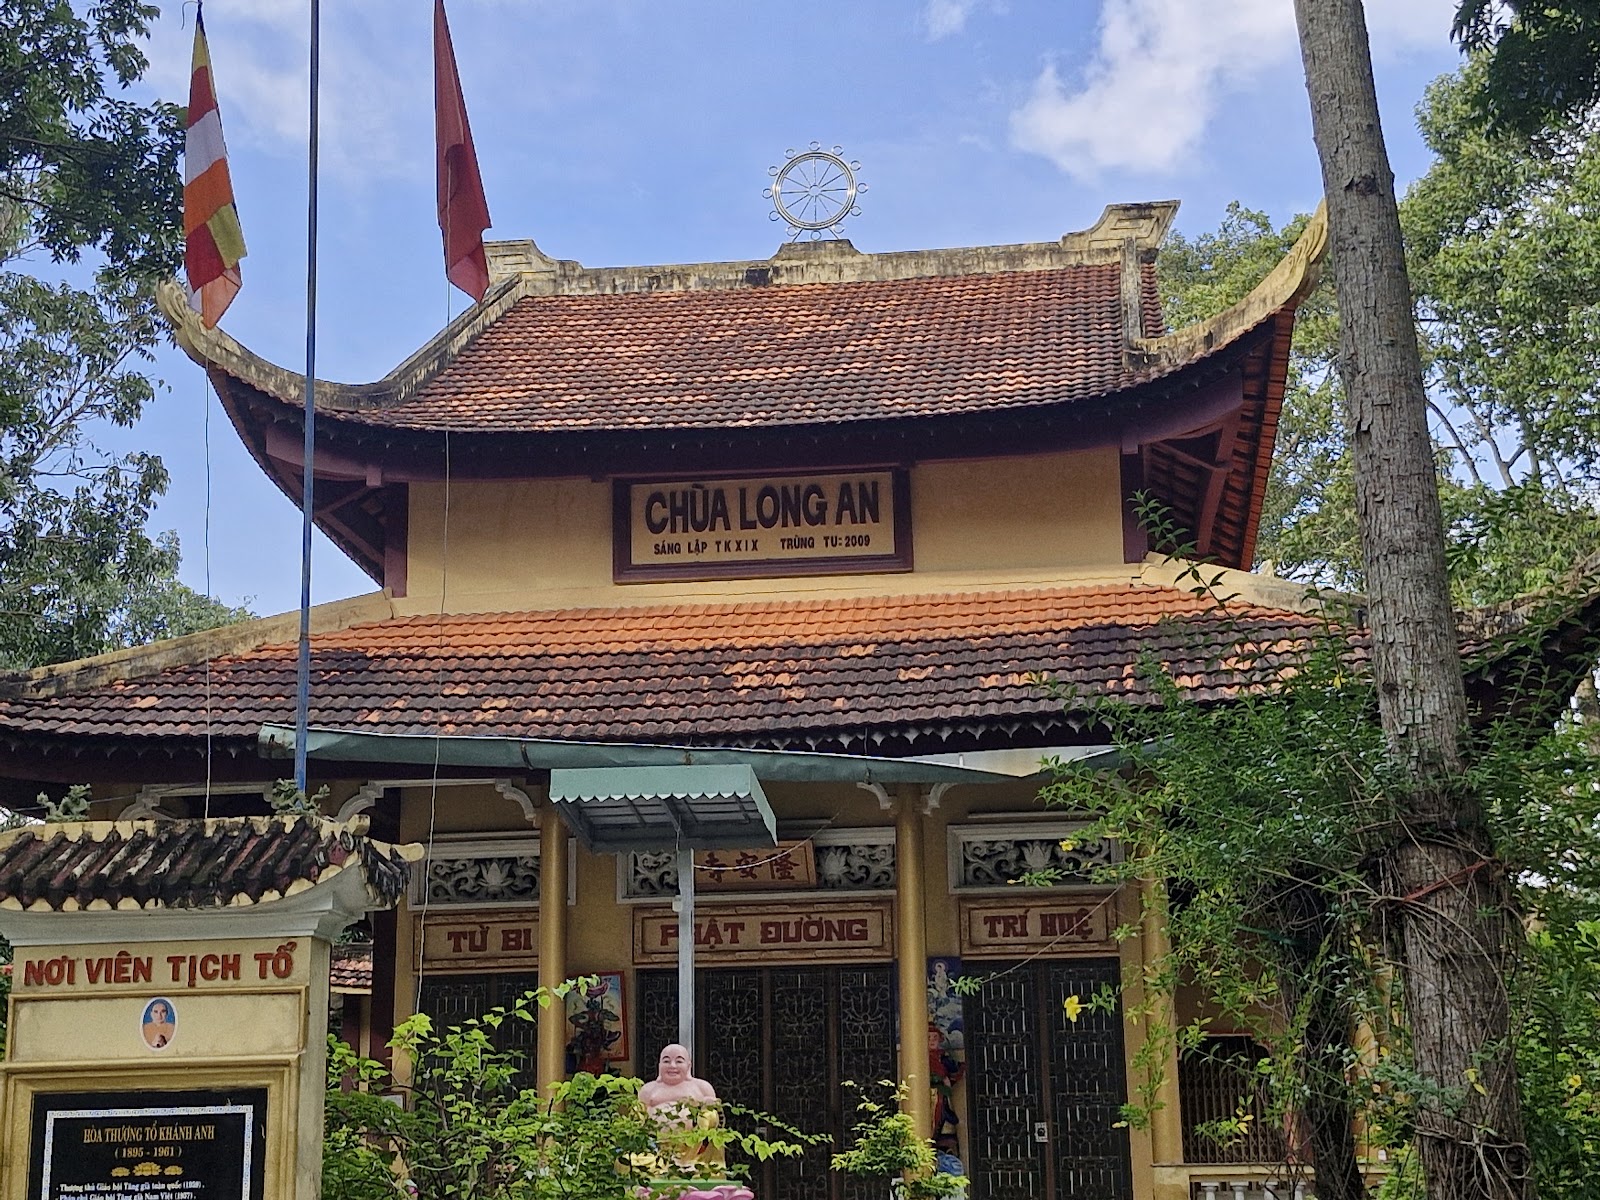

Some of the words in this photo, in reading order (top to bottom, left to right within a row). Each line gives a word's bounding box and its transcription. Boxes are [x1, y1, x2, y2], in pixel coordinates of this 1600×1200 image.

[645, 484, 731, 534] CHÙA
[739, 484, 828, 530] LONG
[835, 480, 880, 526] AN
[653, 539, 682, 555] SÁNG
[687, 537, 708, 555] LẬP
[780, 534, 815, 550] TRÙNG
[447, 924, 490, 953] TỪ
[501, 928, 532, 951] BI
[760, 914, 868, 944] ĐƯỜNG
[983, 908, 1030, 937] TRÍ
[1040, 908, 1093, 940] HUỆ
[24, 955, 76, 986] NƠI
[85, 950, 153, 984] VIÊN
[166, 953, 241, 987] TỊCH
[254, 941, 298, 979] TỔ
[83, 1125, 102, 1143] HÒA
[104, 1125, 143, 1145] THƯỢNG
[159, 1122, 193, 1141] KHÁNH
[194, 1125, 215, 1140] ANH
